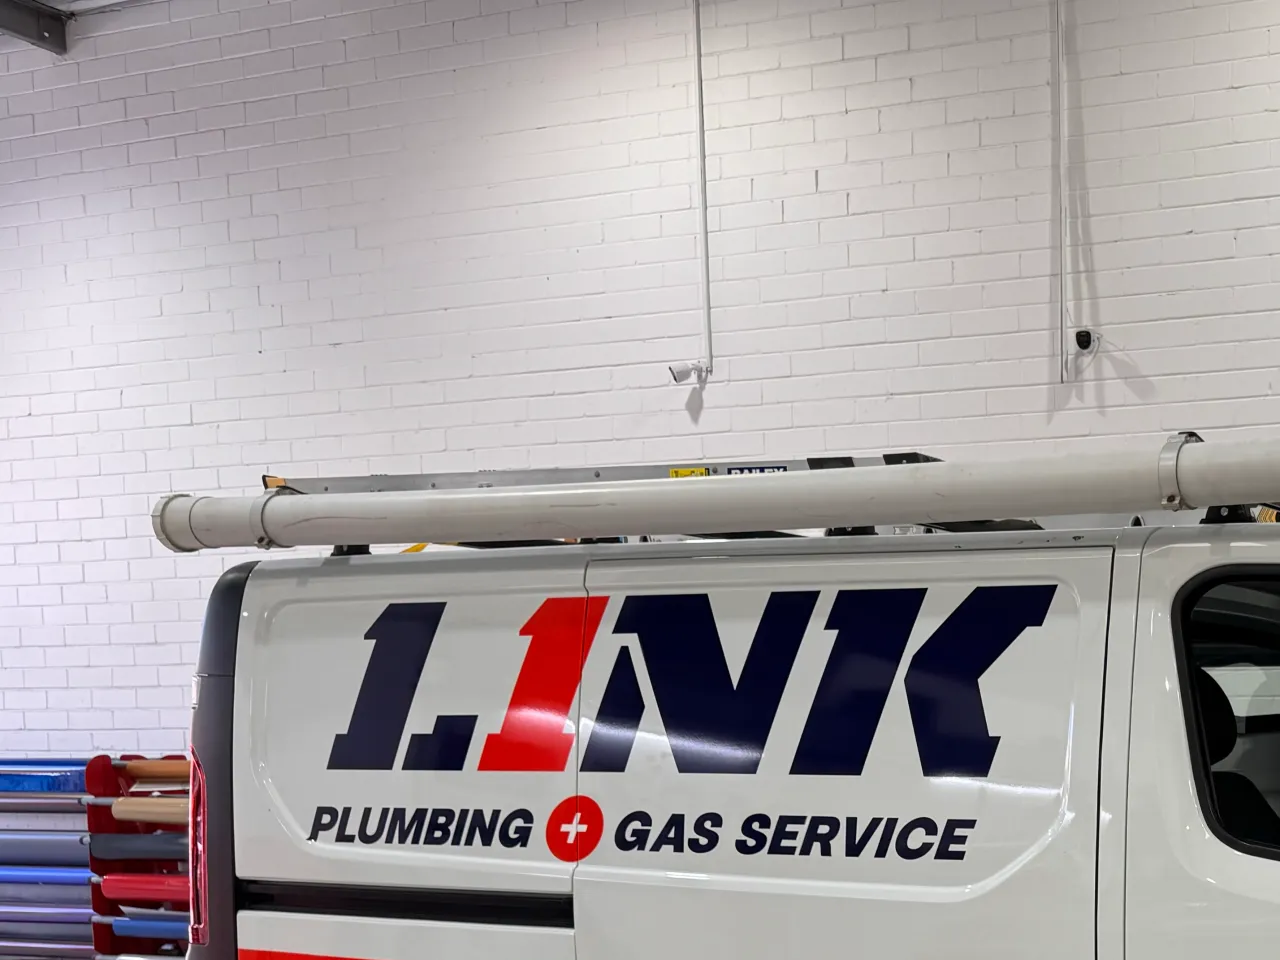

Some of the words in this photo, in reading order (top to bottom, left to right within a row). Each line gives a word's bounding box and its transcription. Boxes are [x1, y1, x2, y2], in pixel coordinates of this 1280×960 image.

[327, 585, 1058, 777] LINK
[309, 807, 534, 848] PLUMBING
[614, 811, 723, 853] GAS
[735, 814, 977, 860] SERVICE
